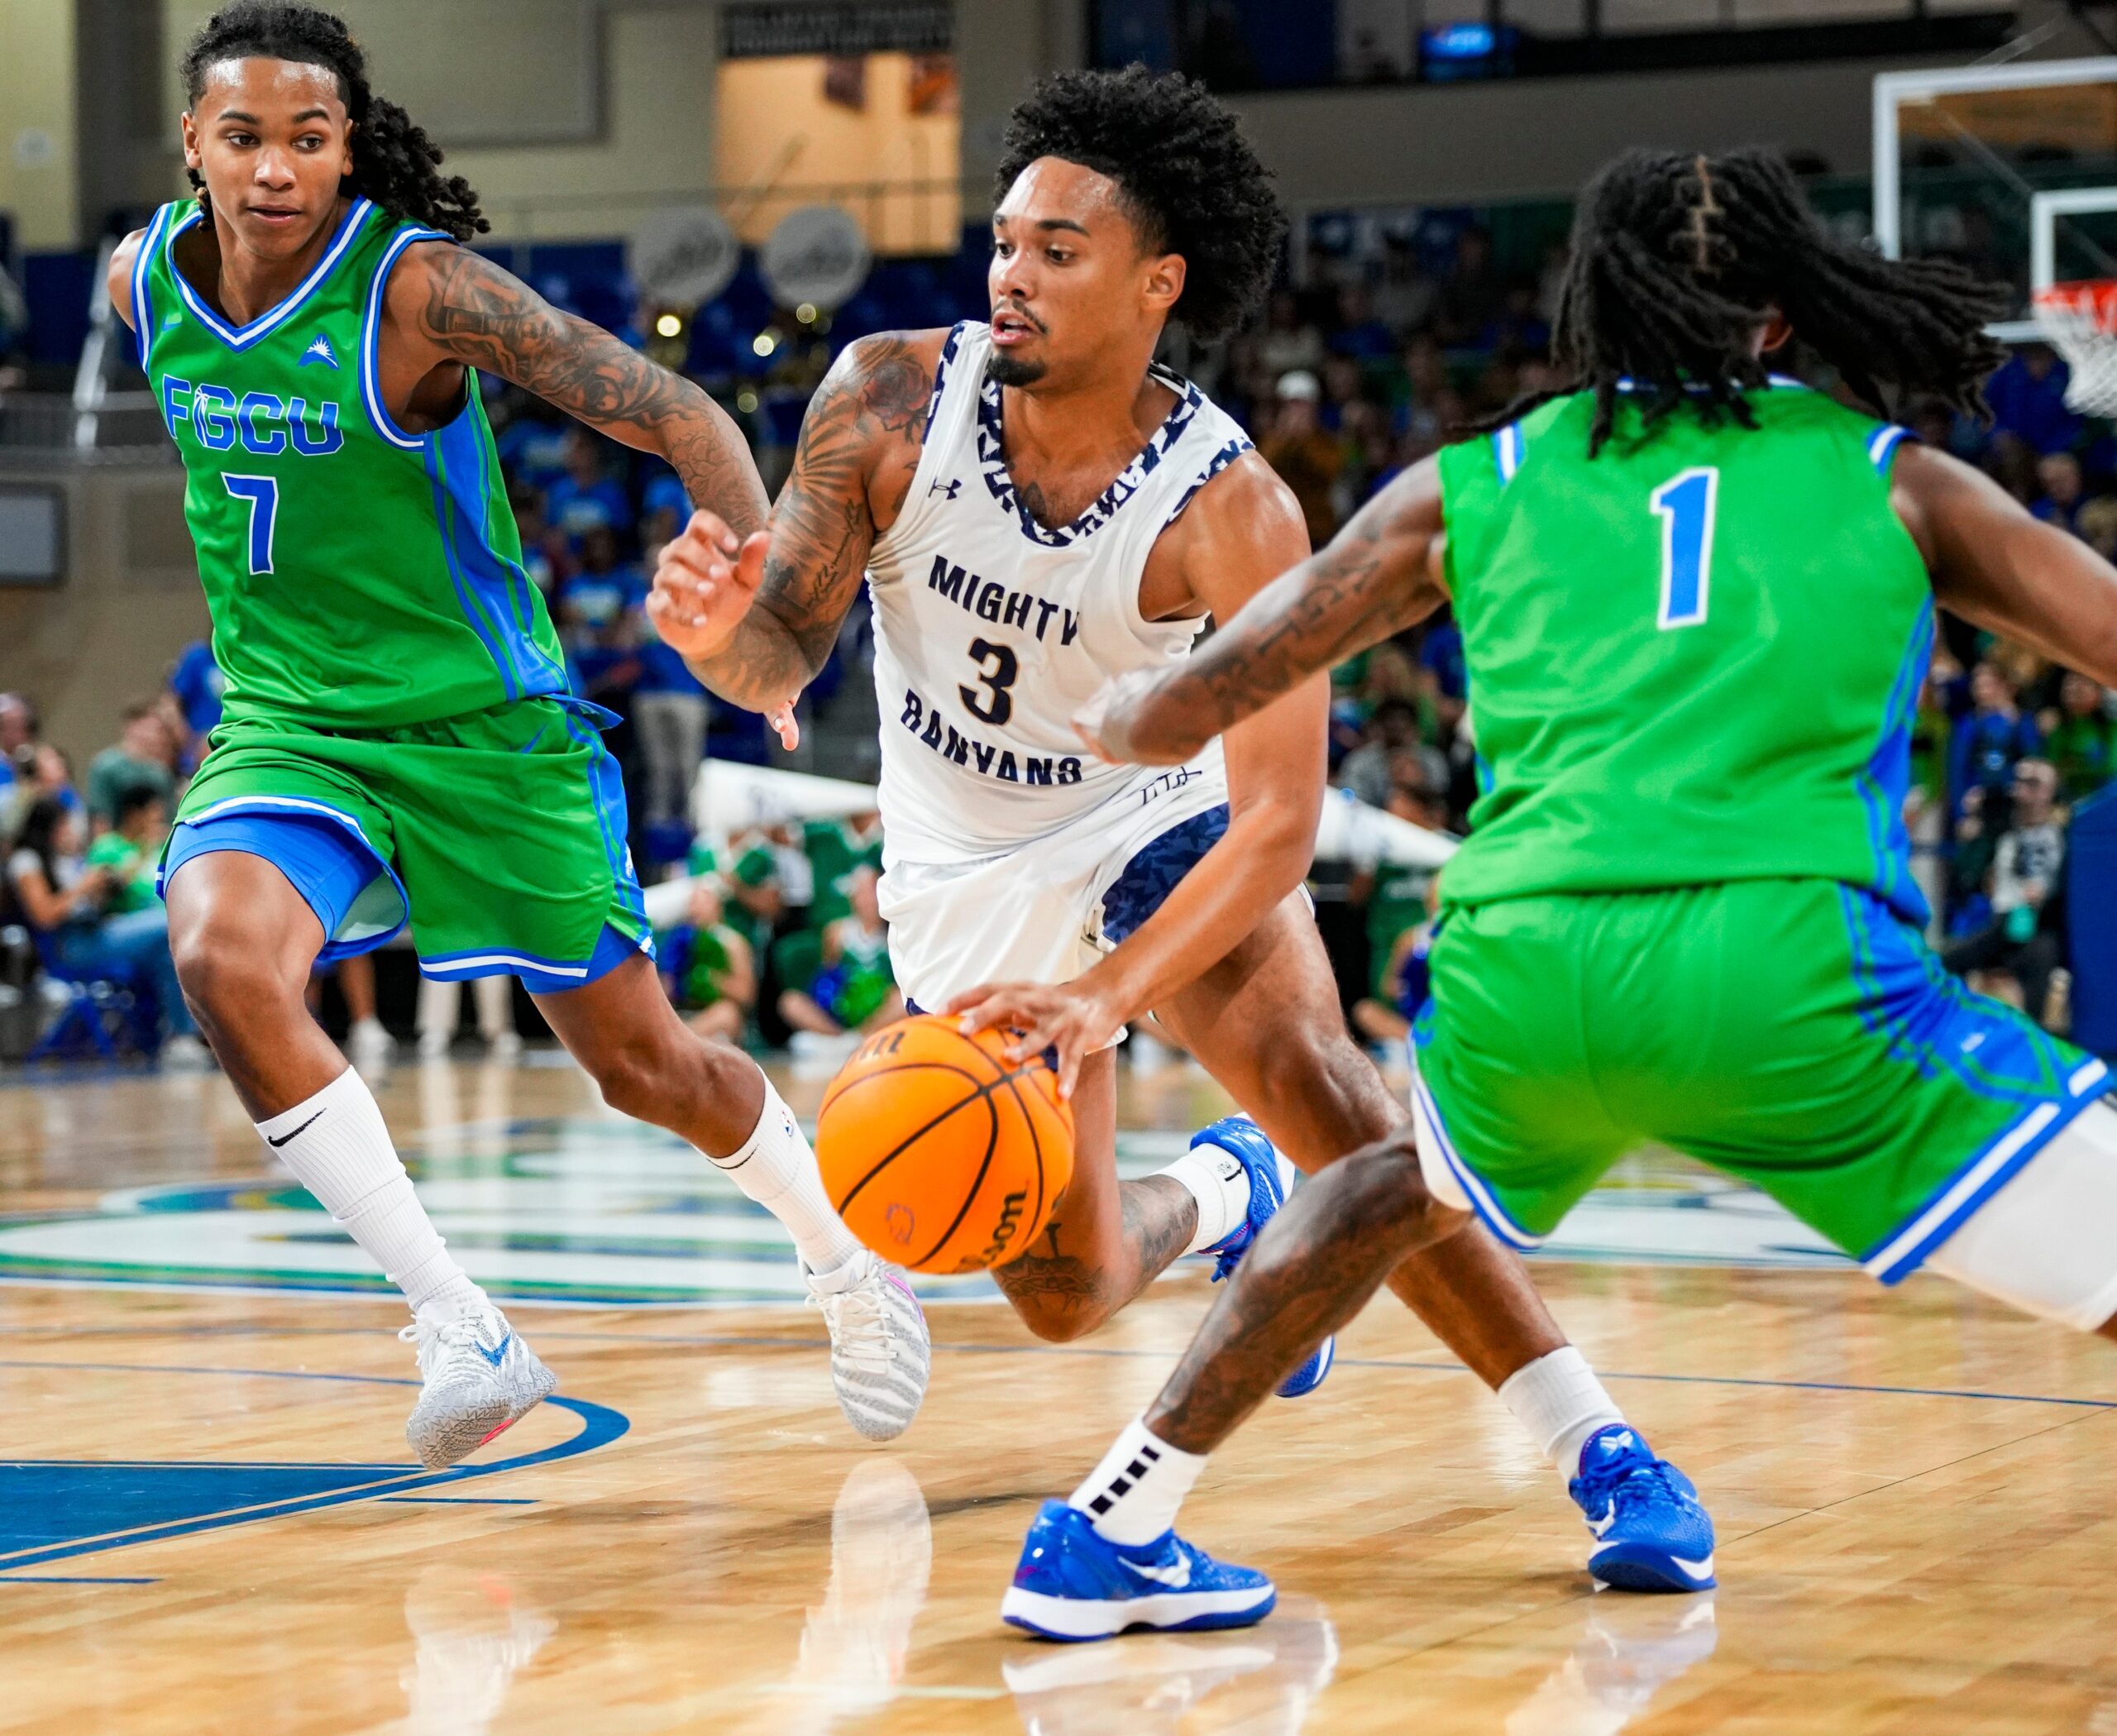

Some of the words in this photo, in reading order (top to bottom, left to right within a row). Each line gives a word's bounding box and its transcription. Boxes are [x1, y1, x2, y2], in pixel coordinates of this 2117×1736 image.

[162, 373, 344, 456] FGCU
[220, 471, 279, 576] 7
[1649, 466, 1719, 631] 1
[927, 554, 1080, 647] MIGHTY
[957, 635, 1020, 727] 3
[900, 687, 1083, 786] BANYANS
